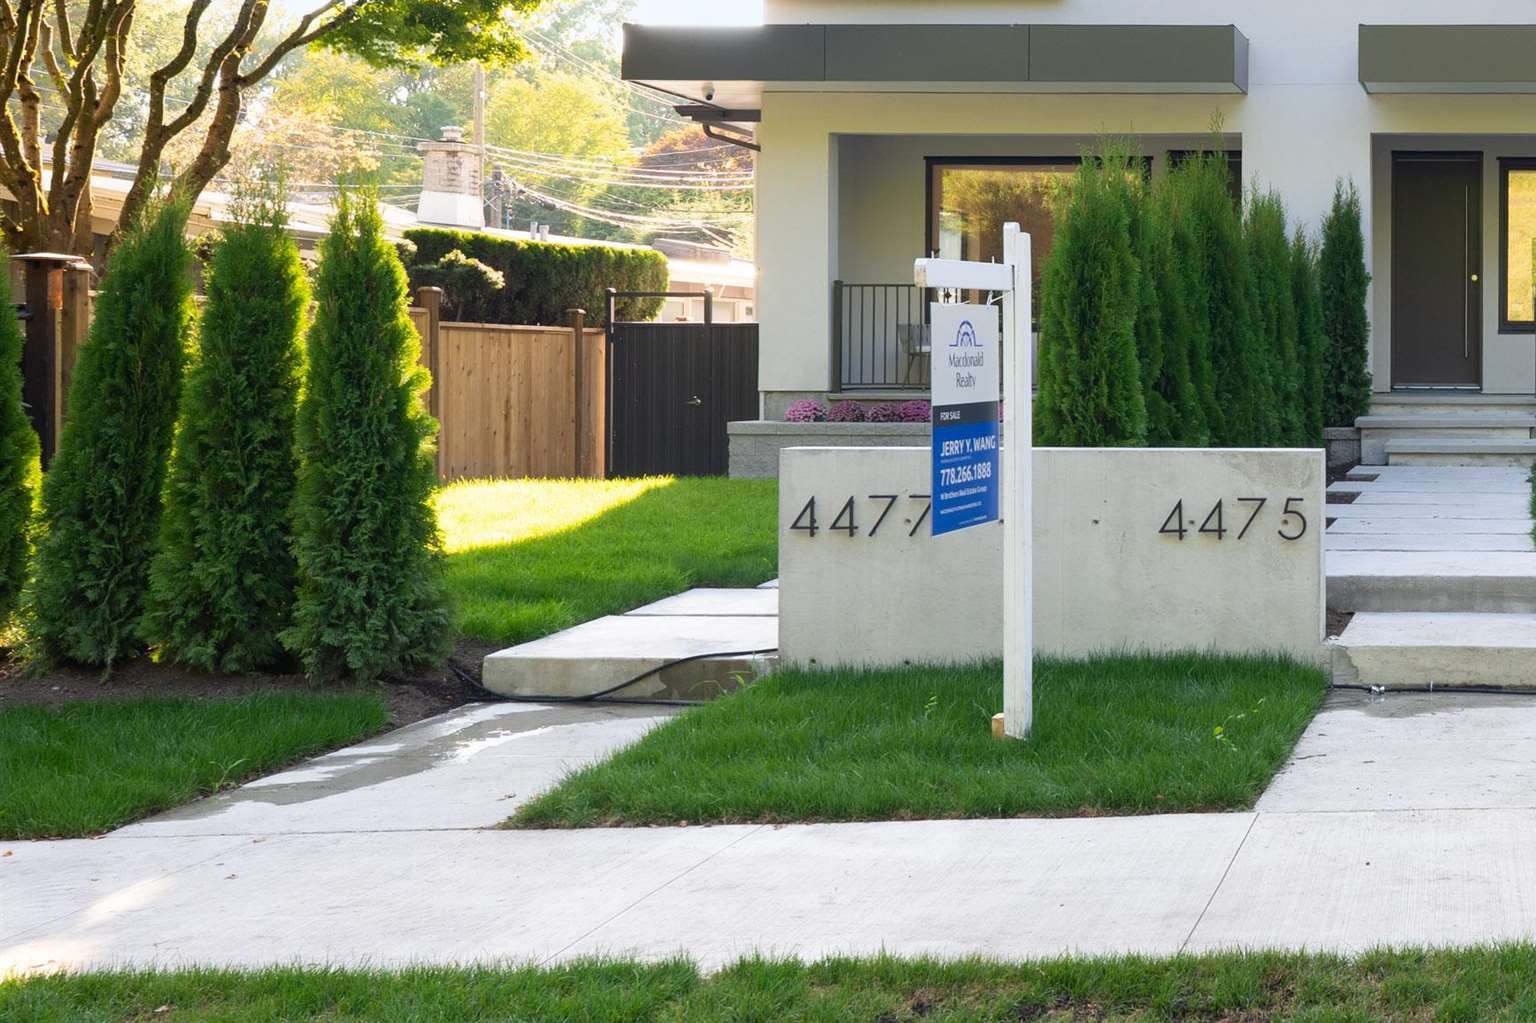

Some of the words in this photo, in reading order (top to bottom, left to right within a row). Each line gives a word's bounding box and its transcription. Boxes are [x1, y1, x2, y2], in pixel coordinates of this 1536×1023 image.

[948, 352, 984, 368] Macdonald
[956, 372, 976, 389] Realty
[940, 411, 949, 421] FOR
[950, 410, 961, 420] SALE
[941, 440, 965, 456] JERRY
[965, 438, 973, 453] Y.
[973, 435, 996, 452] WANG
[941, 462, 992, 486] 778.266.1888
[790, 495, 931, 537] 4477
[1158, 498, 1307, 541] 4475
